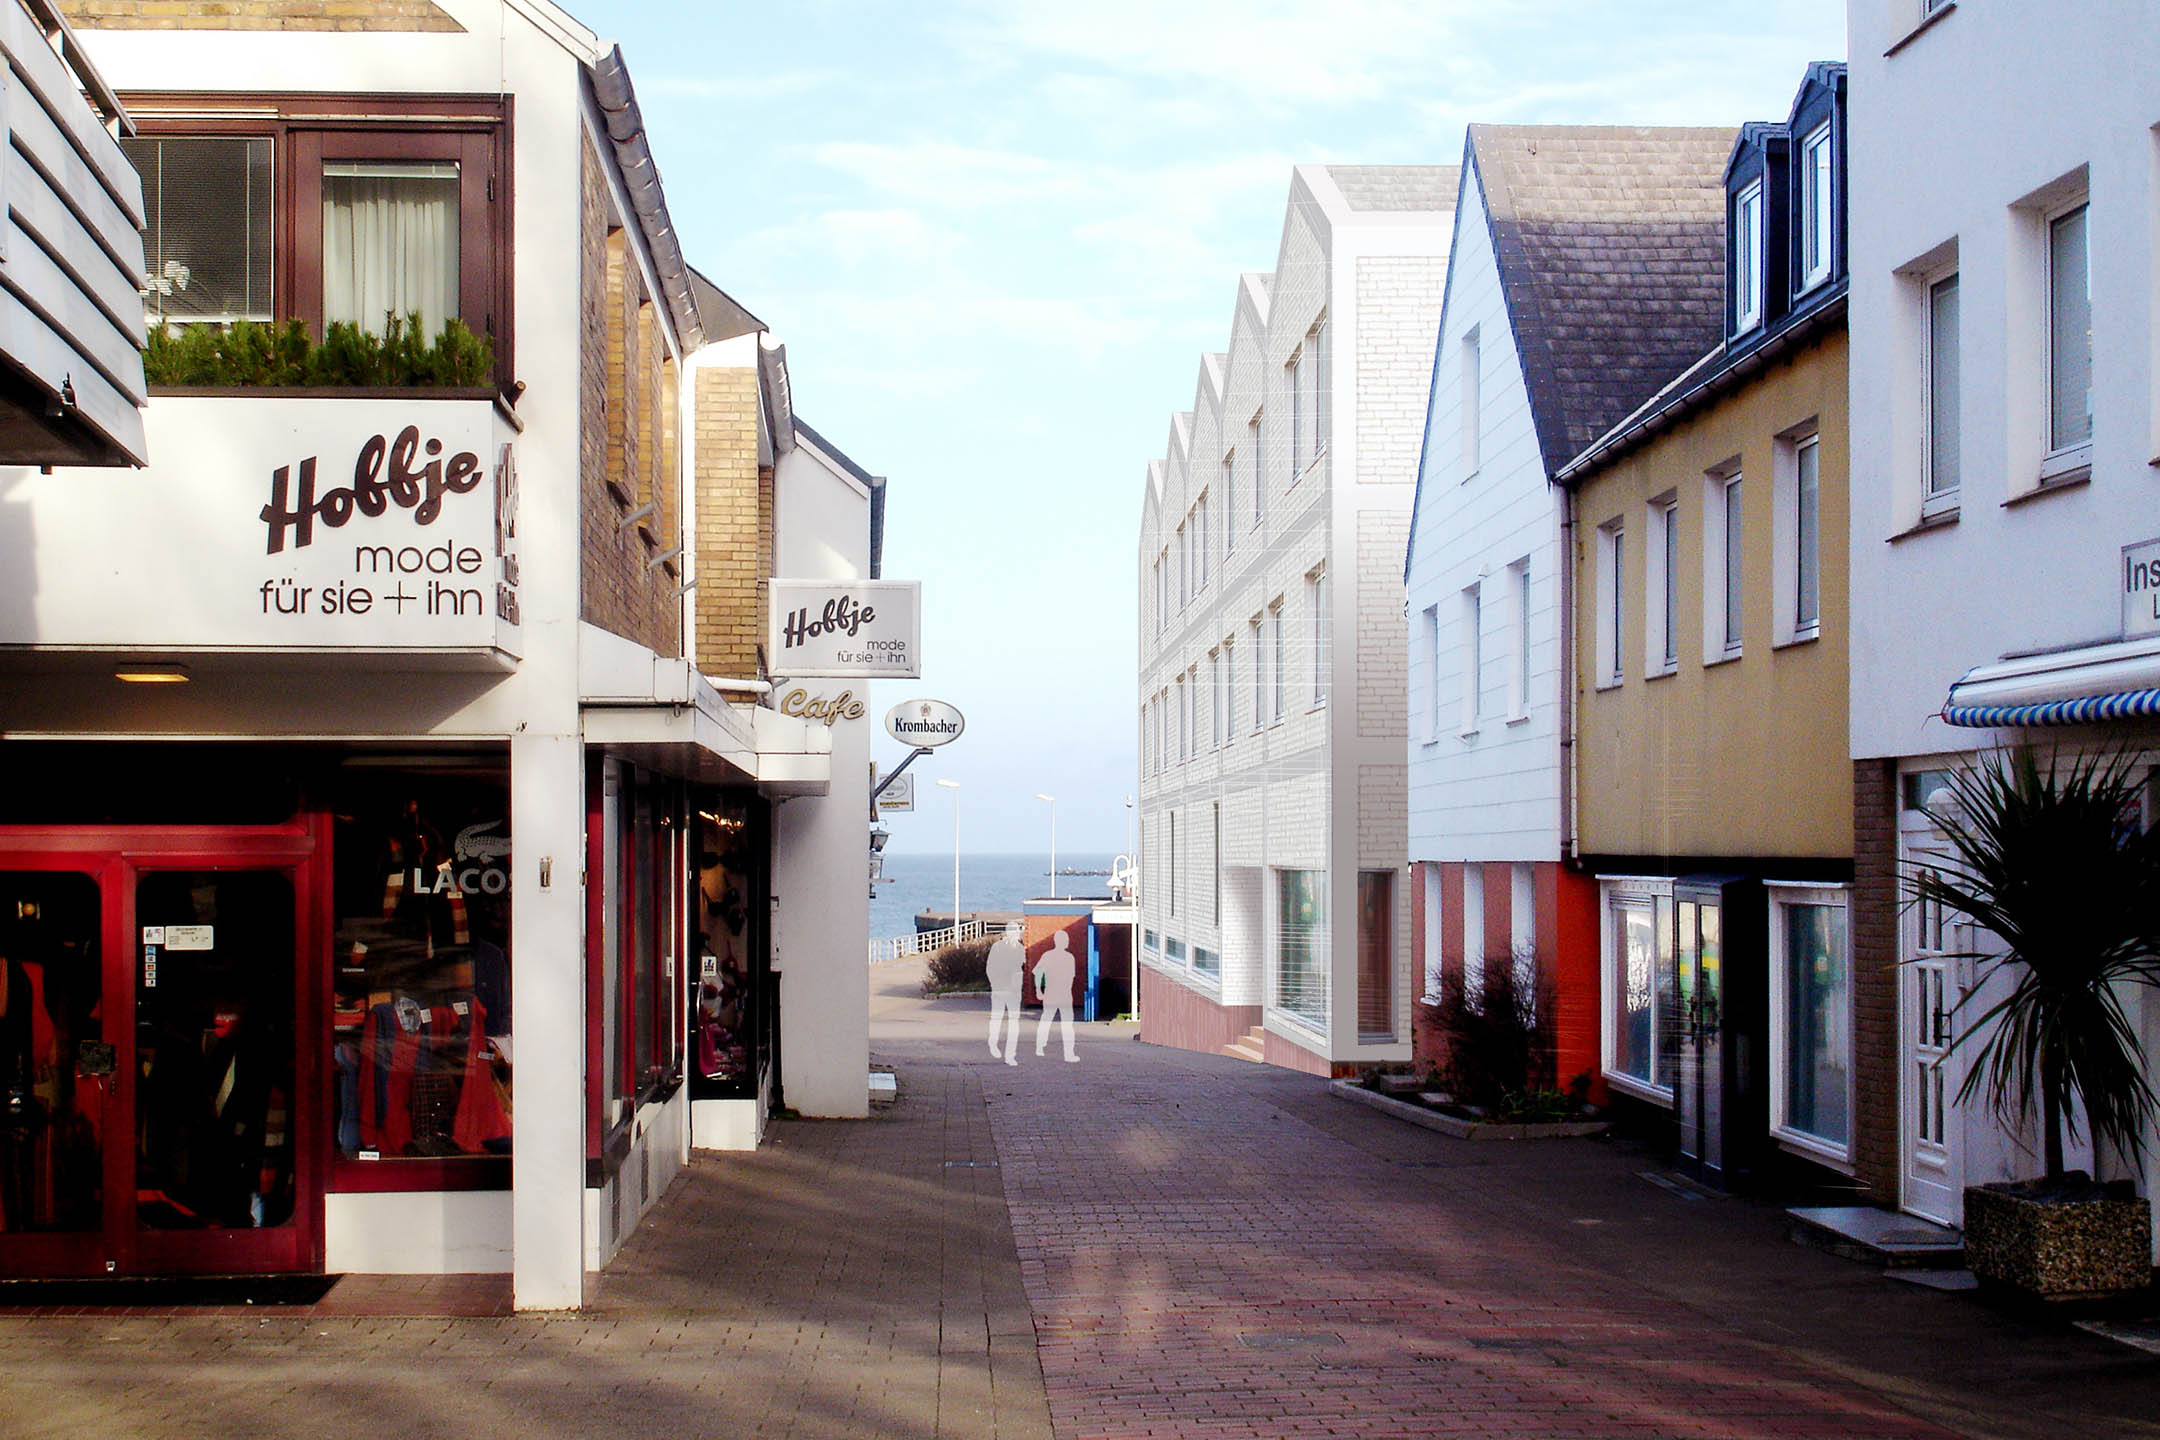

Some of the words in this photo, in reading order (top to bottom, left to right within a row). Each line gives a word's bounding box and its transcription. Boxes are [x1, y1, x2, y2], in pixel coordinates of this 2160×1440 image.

[259, 425, 483, 555] Hobbje
[355, 539, 482, 574] mode
[260, 578, 312, 614] für
[321, 580, 373, 615] sie
[384, 580, 417, 615] +
[428, 580, 483, 615] ihn
[783, 594, 876, 649] Hobbje
[837, 650, 853, 663] für
[856, 651, 873, 663] sie
[887, 651, 906, 663] ihn
[866, 639, 906, 651] mode
[895, 717, 958, 734] Krombacher
[413, 867, 512, 895] LACO
